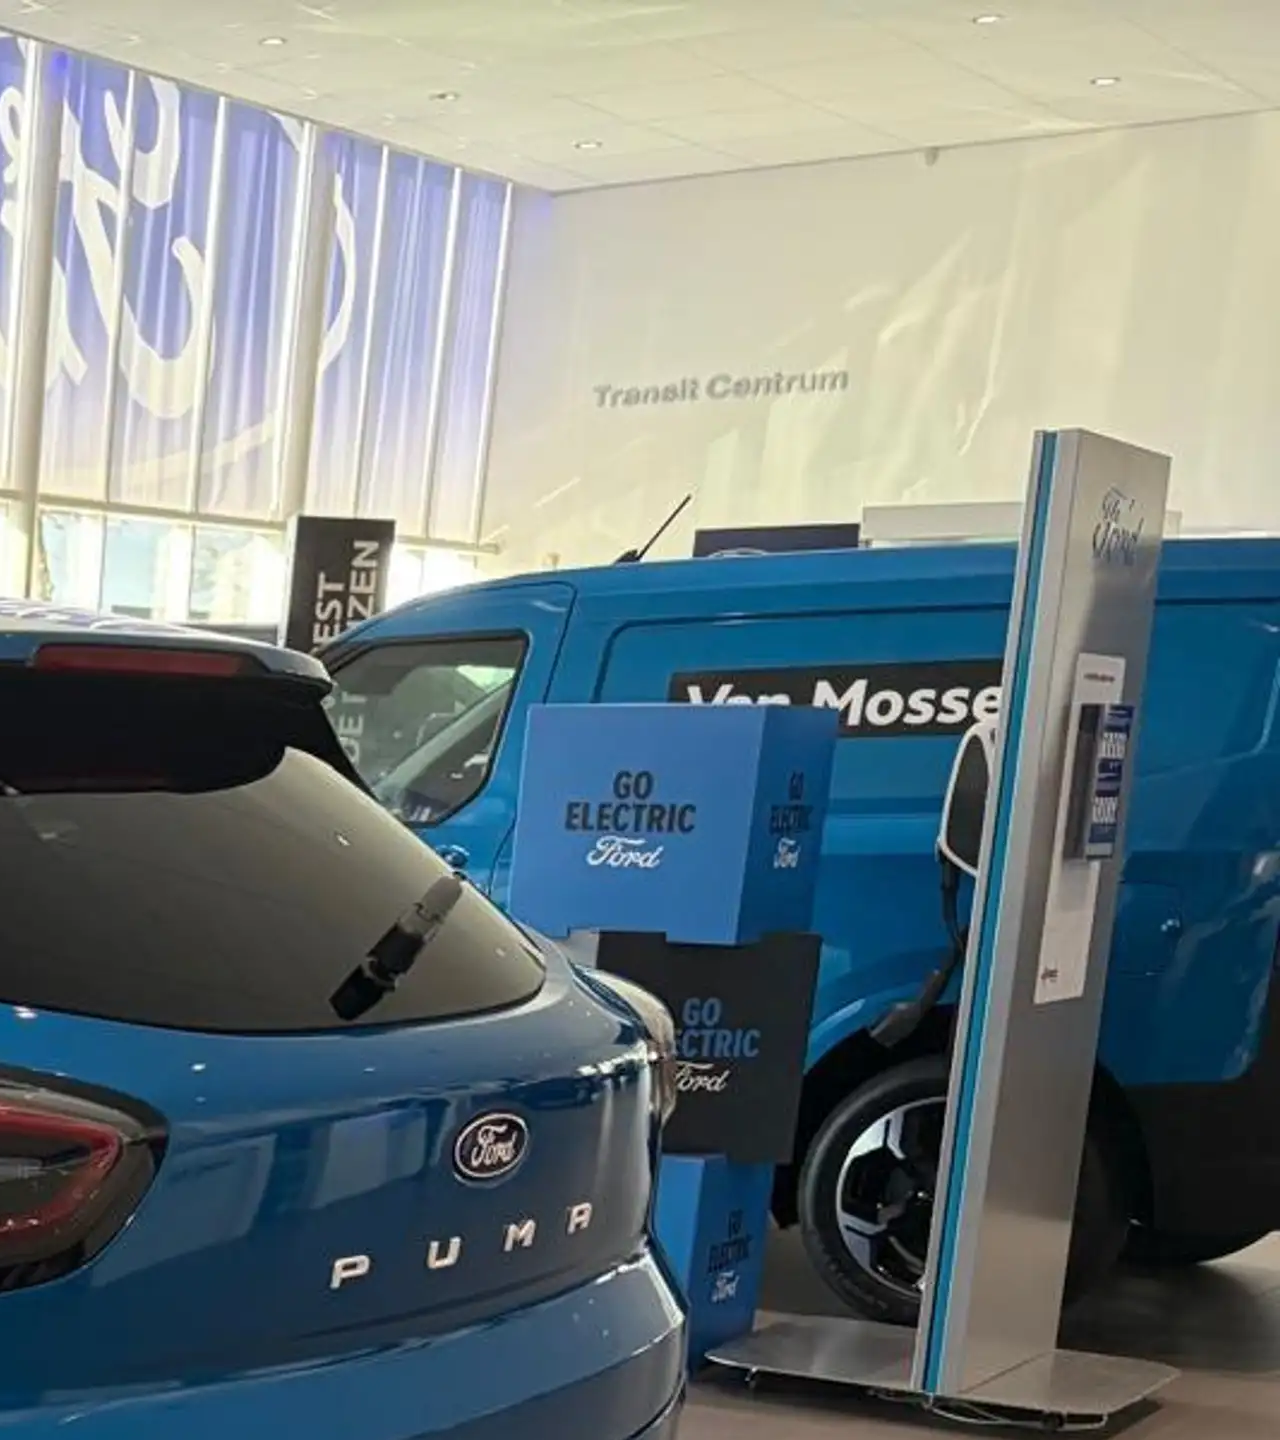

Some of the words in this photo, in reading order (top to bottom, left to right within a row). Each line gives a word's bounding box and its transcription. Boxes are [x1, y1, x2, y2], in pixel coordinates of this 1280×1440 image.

[593, 377, 699, 408] Transit
[705, 371, 849, 401] Centrum
[310, 571, 346, 656] EST
[613, 770, 654, 800] GO
[565, 802, 696, 833] ELECTRIC
[587, 835, 664, 868] Ford
[682, 997, 722, 1027] GO
[471, 1124, 517, 1168] Ford
[330, 1202, 592, 1289] PUMA
